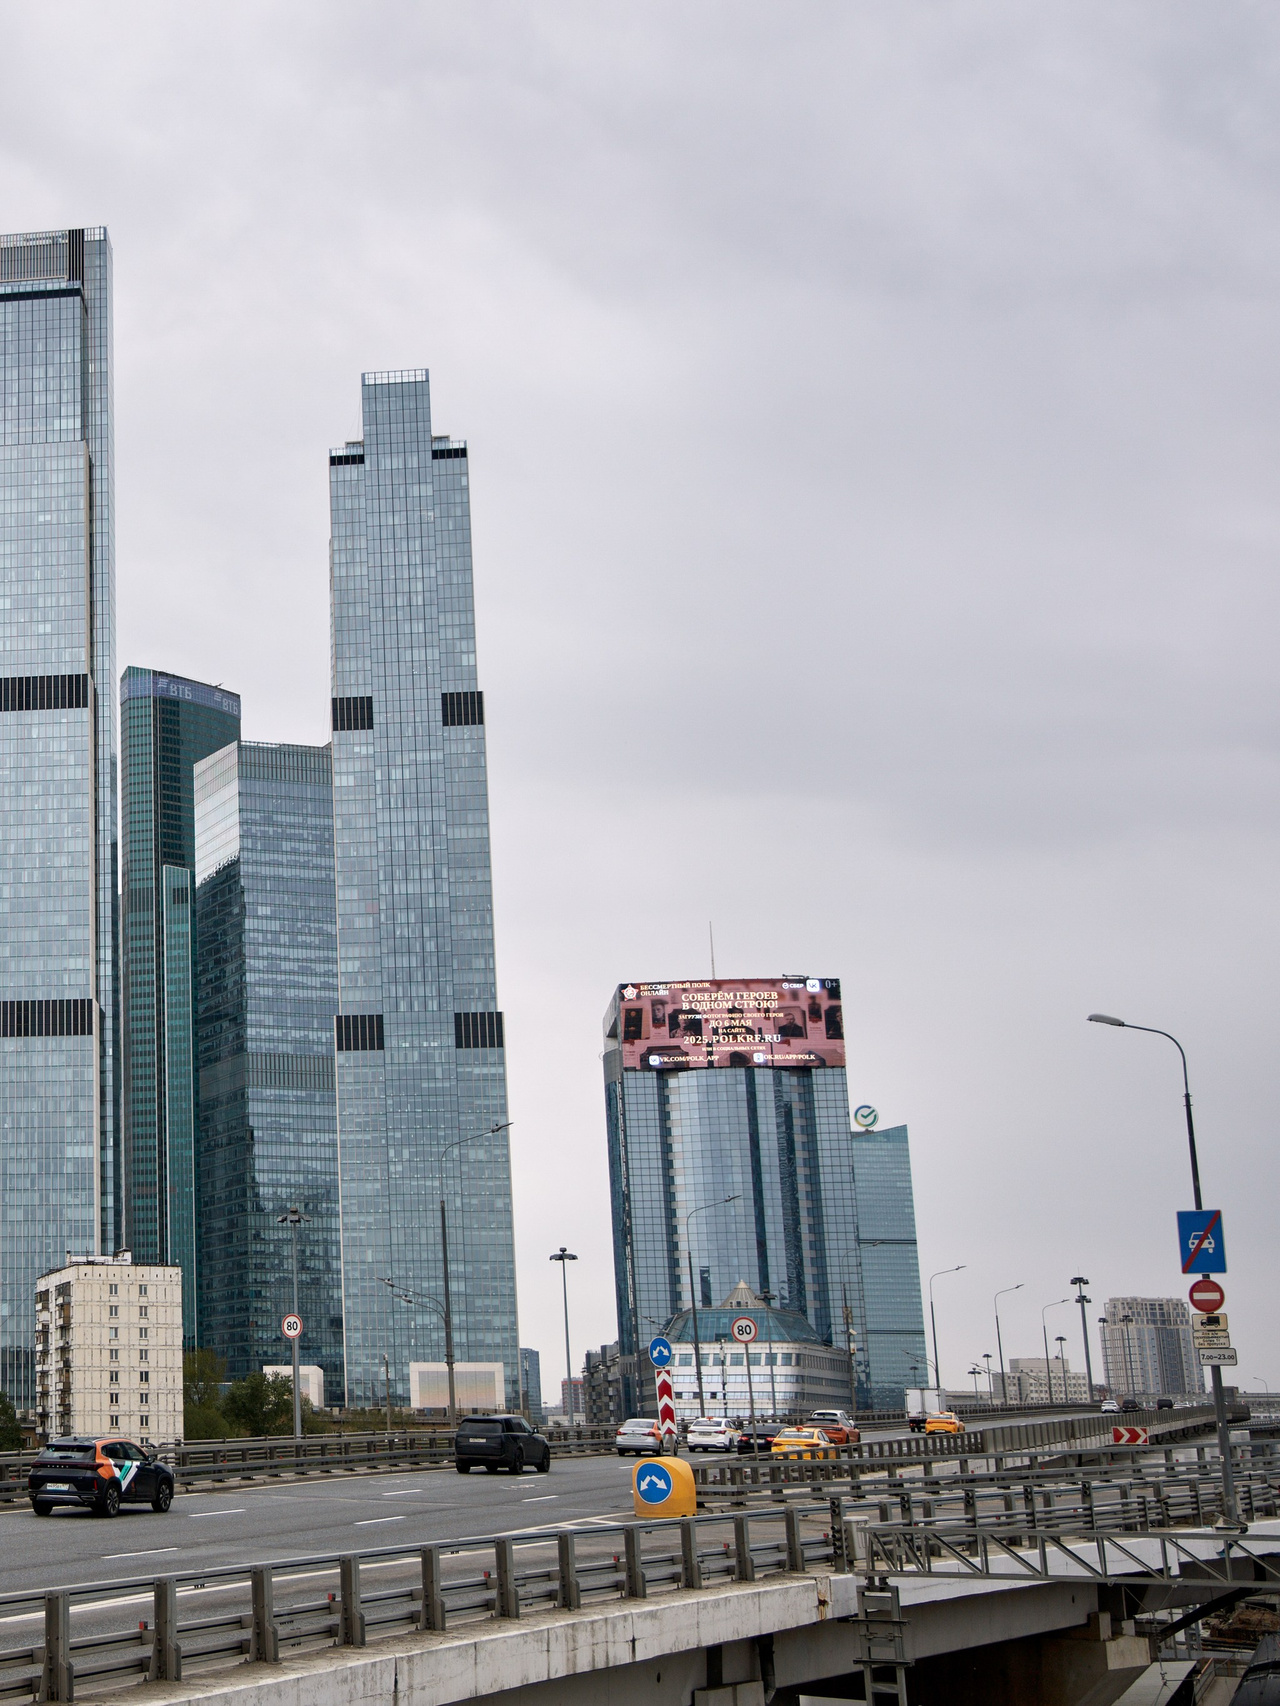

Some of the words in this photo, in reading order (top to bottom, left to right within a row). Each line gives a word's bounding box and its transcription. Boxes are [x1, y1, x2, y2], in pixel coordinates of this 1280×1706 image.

[170, 684, 192, 699] ВТБ
[222, 699, 239, 715] ВТБ
[640, 982, 691, 991] БЕССМЕРТНЫЙ
[825, 980, 838, 988] 0+
[681, 991, 734, 1002] СОБЕРЁМ
[736, 992, 778, 1000] ГЕРОЕВ
[682, 1002, 690, 1010] В
[692, 1001, 732, 1011] ОДНОМ
[734, 1000, 778, 1009] СТРОЮ!
[709, 1020, 722, 1028] ДО
[683, 1034, 782, 1044] 2025.POLKRF.RU
[286, 1321, 298, 1331] 80
[736, 1324, 752, 1336] 80
